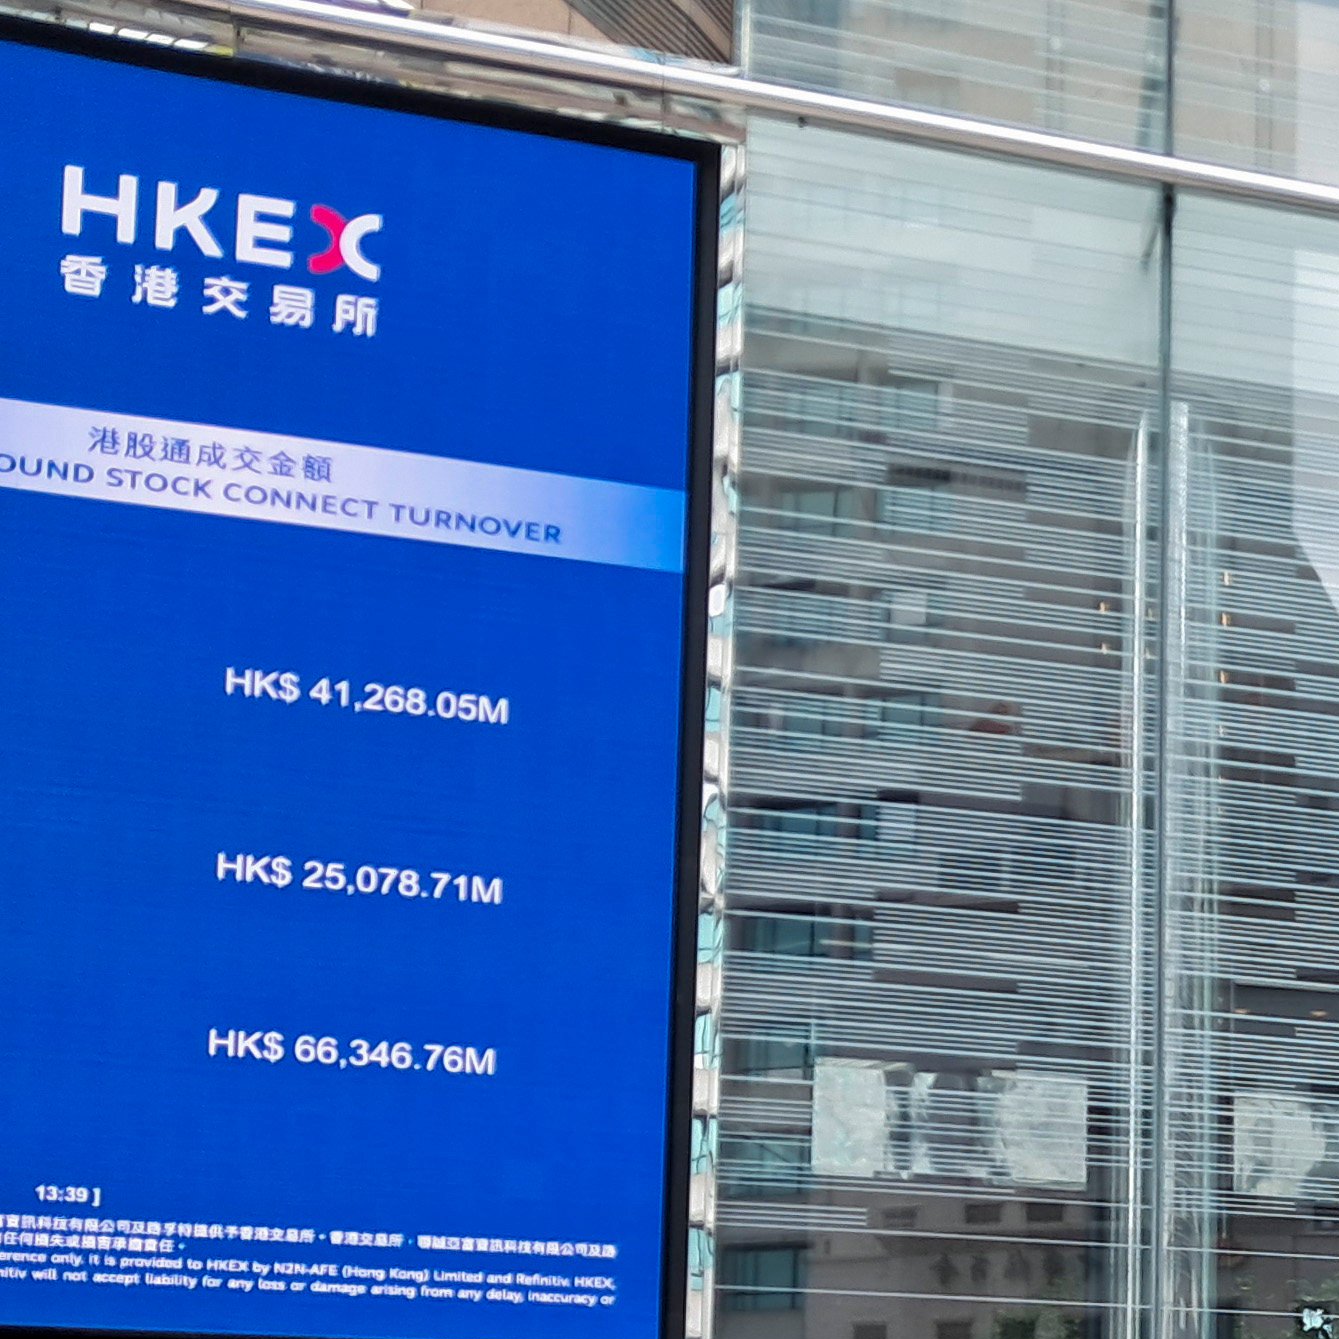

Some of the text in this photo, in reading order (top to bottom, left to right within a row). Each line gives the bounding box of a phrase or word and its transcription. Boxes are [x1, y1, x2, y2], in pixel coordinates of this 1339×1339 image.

[60, 164, 384, 281] HKEX
[60, 254, 380, 337] 香港交易所
[88, 425, 335, 484] 港股通成交金額
[107, 467, 213, 500] STOCK
[224, 481, 379, 522] CONNECT
[389, 502, 562, 546] TURNOVER
[226, 667, 509, 725] HK$ 41,268.05M
[217, 852, 502, 906] HK$ 25,078.71M
[208, 1028, 496, 1076] HK$ 66,346.76M
[35, 1185, 89, 1203] 13:39
[31, 1268, 58, 1281] will
[62, 1271, 87, 1282] not
[145, 1272, 197, 1289] liability
[202, 1275, 222, 1288] for
[227, 1279, 254, 1292] any
[457, 1289, 483, 1302] any
[187, 1258, 204, 1270] to
[207, 1259, 249, 1272] HKEX
[252, 1262, 271, 1275] by
[433, 1271, 483, 1283] Limited
[486, 1273, 513, 1284] and
